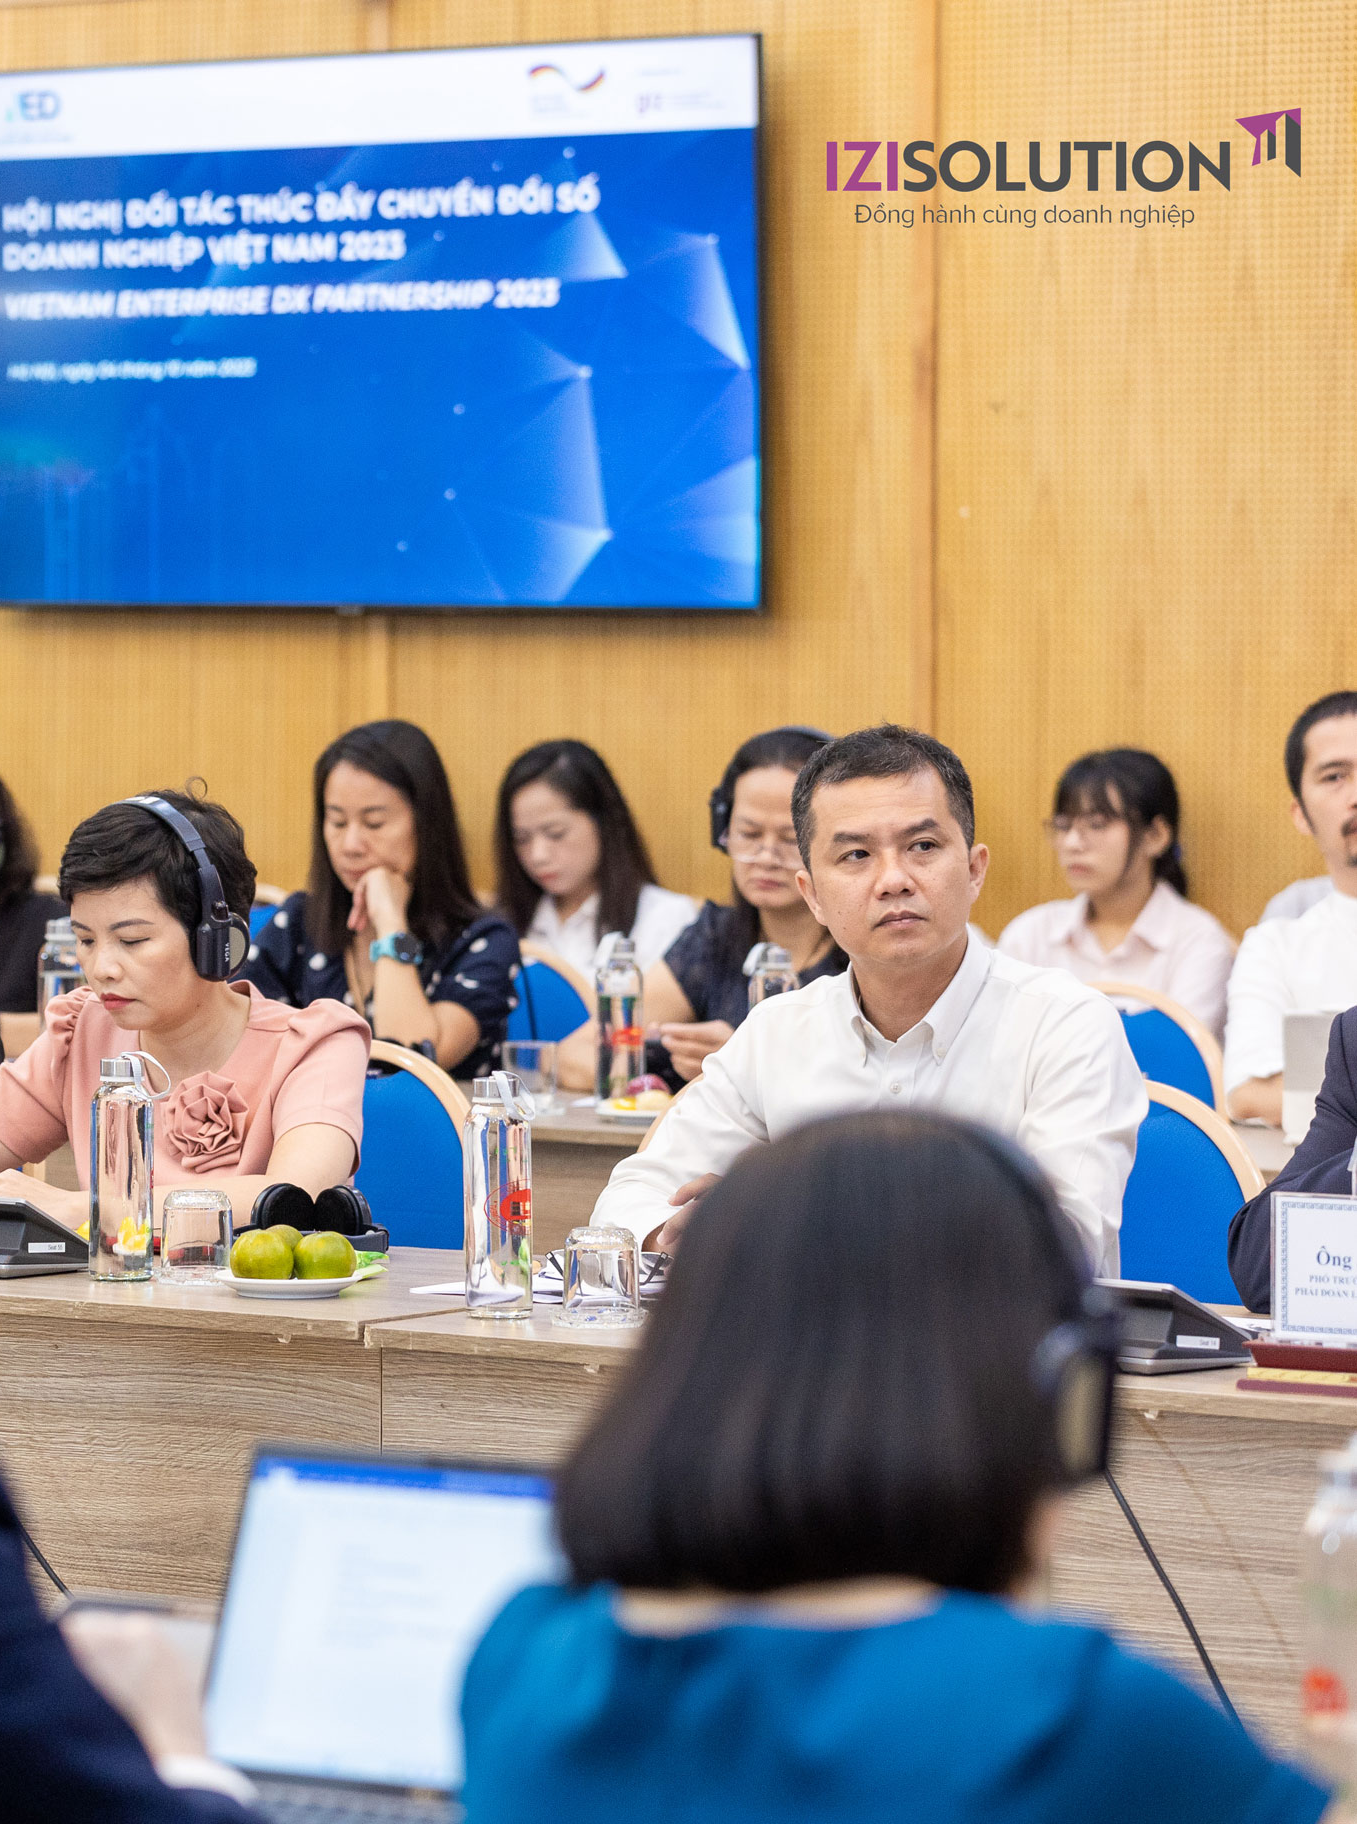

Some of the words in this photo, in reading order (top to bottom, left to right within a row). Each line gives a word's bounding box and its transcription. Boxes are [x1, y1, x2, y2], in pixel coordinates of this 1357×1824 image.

[2, 197, 53, 237] HỘI
[55, 199, 123, 235] NGHỊ
[180, 190, 235, 226] TÁC
[237, 186, 313, 224] THÚC
[556, 172, 601, 213] SỐ
[2, 240, 100, 272] DOANH
[102, 231, 205, 273] NGHIỆP
[207, 229, 269, 270] VIỆT
[272, 231, 338, 264] NAM
[339, 229, 407, 262] 2023
[5, 290, 116, 321] VIETNAM
[116, 285, 271, 318] ENTERPRISE
[271, 283, 313, 314] DX
[313, 279, 494, 313] PARTNERSHIP
[494, 277, 561, 309] 2023
[1317, 1245, 1352, 1271] Ông
